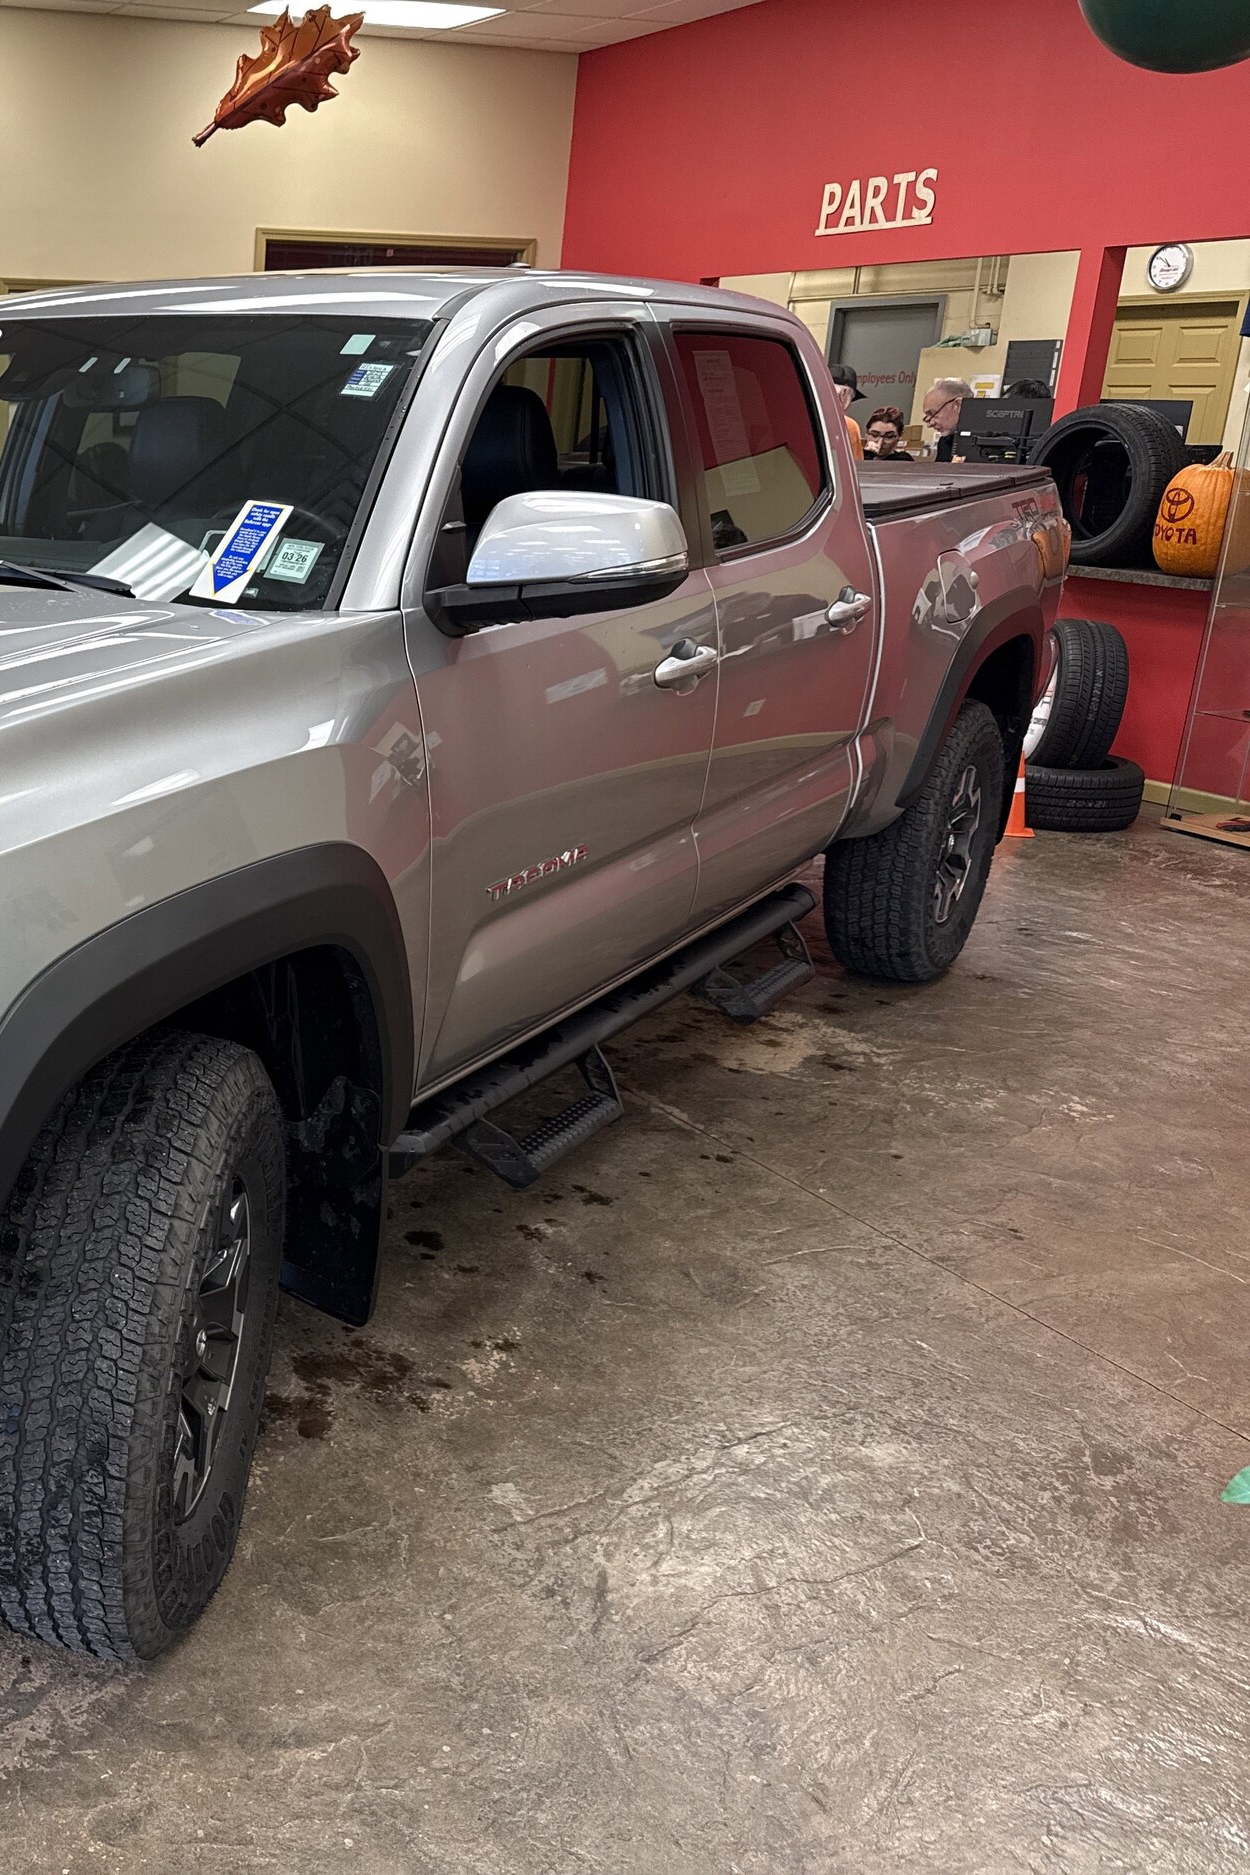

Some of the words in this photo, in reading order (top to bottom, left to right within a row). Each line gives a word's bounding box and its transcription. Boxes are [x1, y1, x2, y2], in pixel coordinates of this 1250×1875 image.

[816, 168, 938, 236] PARTS
[856, 372, 896, 388] mployees
[986, 409, 1024, 418] SCEPTR
[1155, 523, 1197, 545] OYOTA
[281, 551, 294, 561] 03
[295, 554, 309, 563] 26
